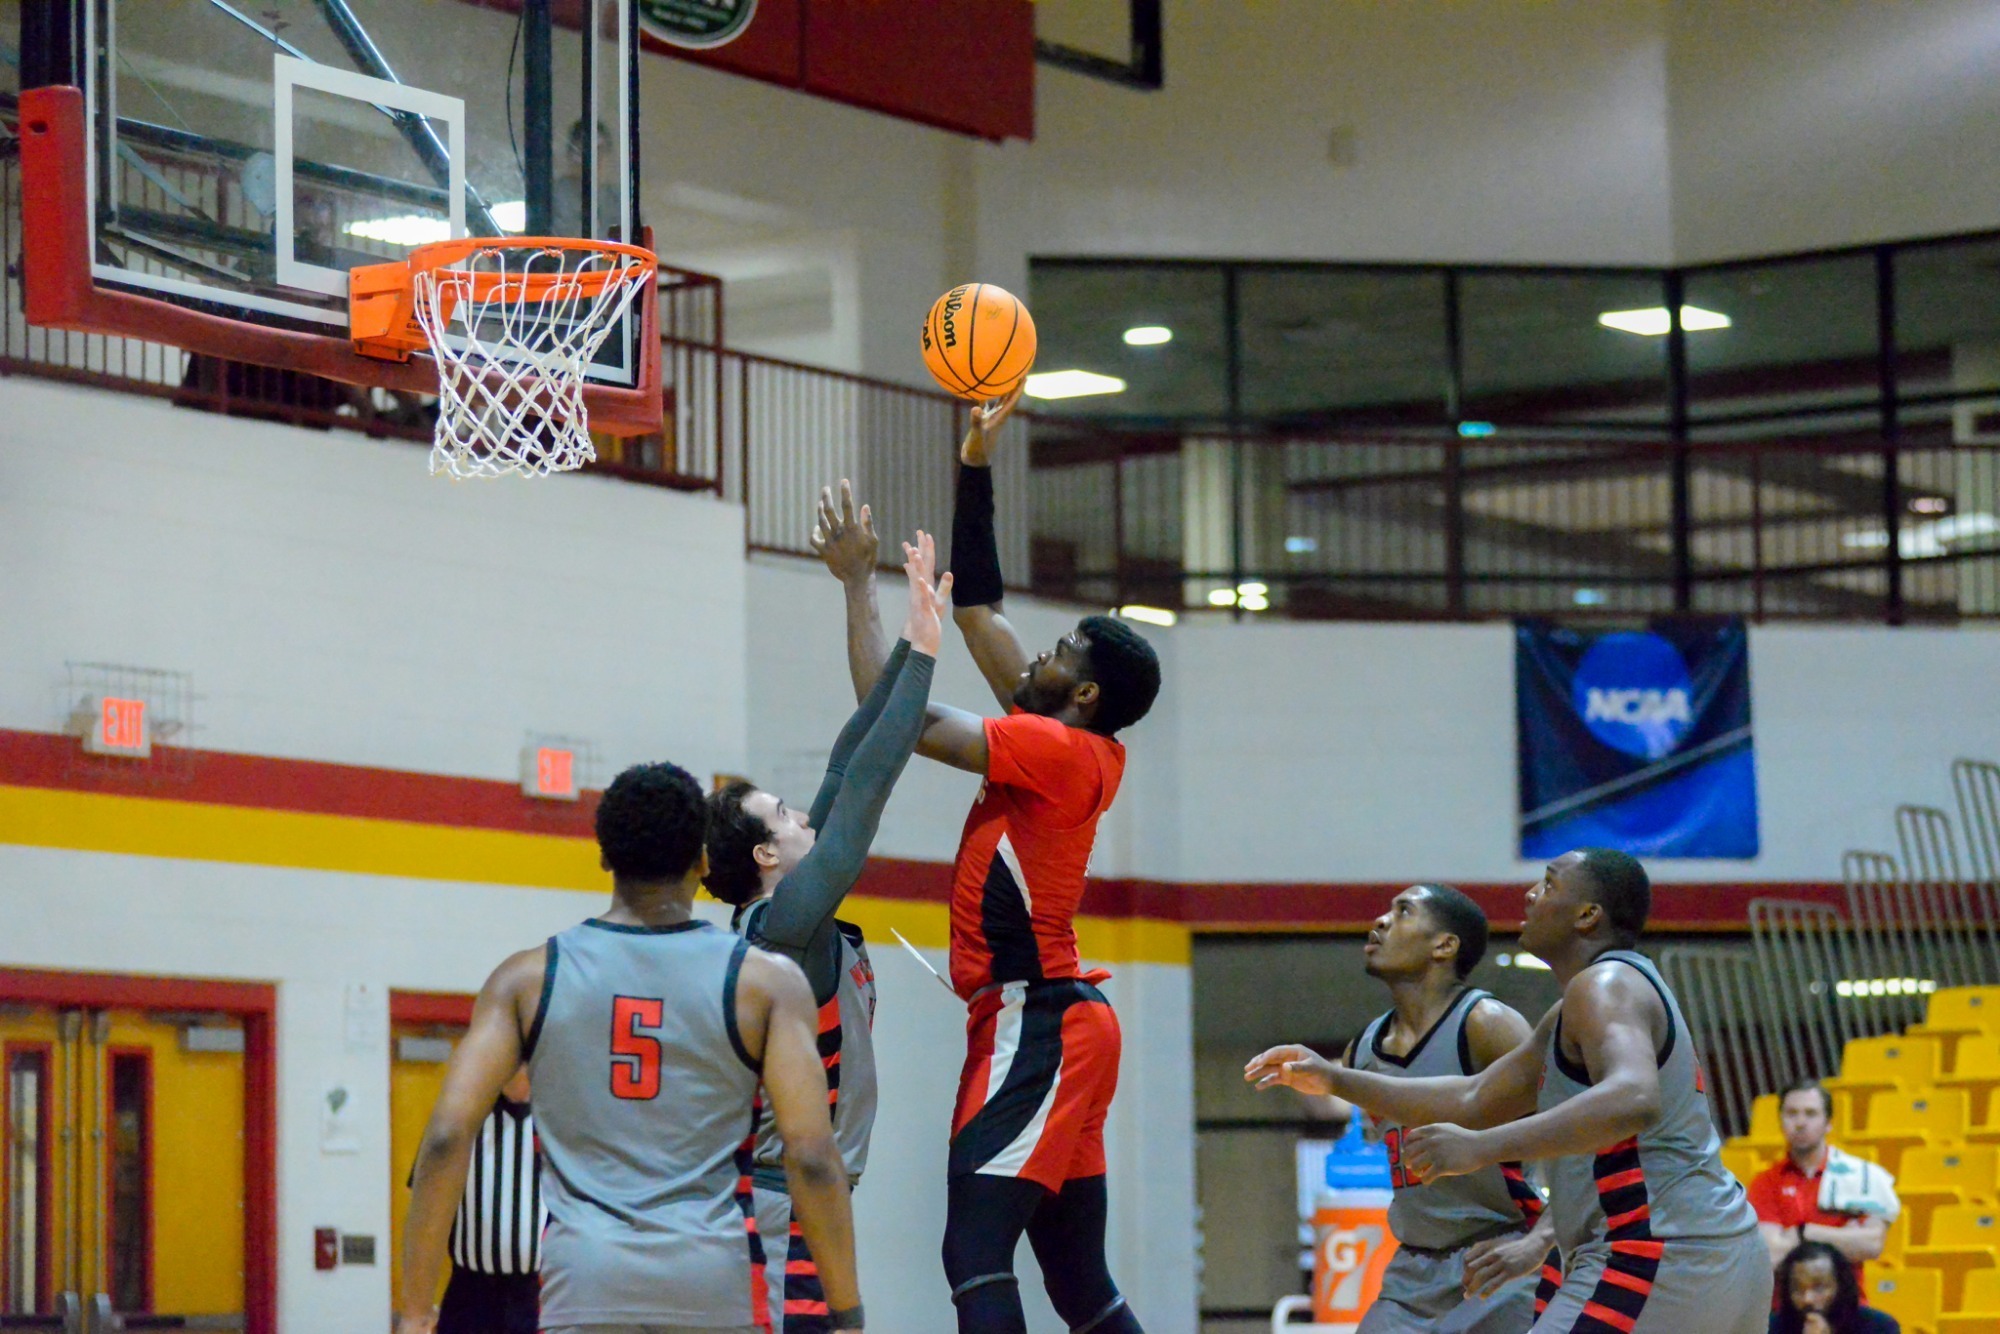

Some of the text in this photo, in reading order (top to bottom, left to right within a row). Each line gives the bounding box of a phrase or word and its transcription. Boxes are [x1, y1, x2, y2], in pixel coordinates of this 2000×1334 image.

[943, 286, 969, 348] Wilson
[102, 697, 145, 747] EXIT
[1585, 687, 1691, 724] NCAA
[609, 994, 664, 1100] 5
